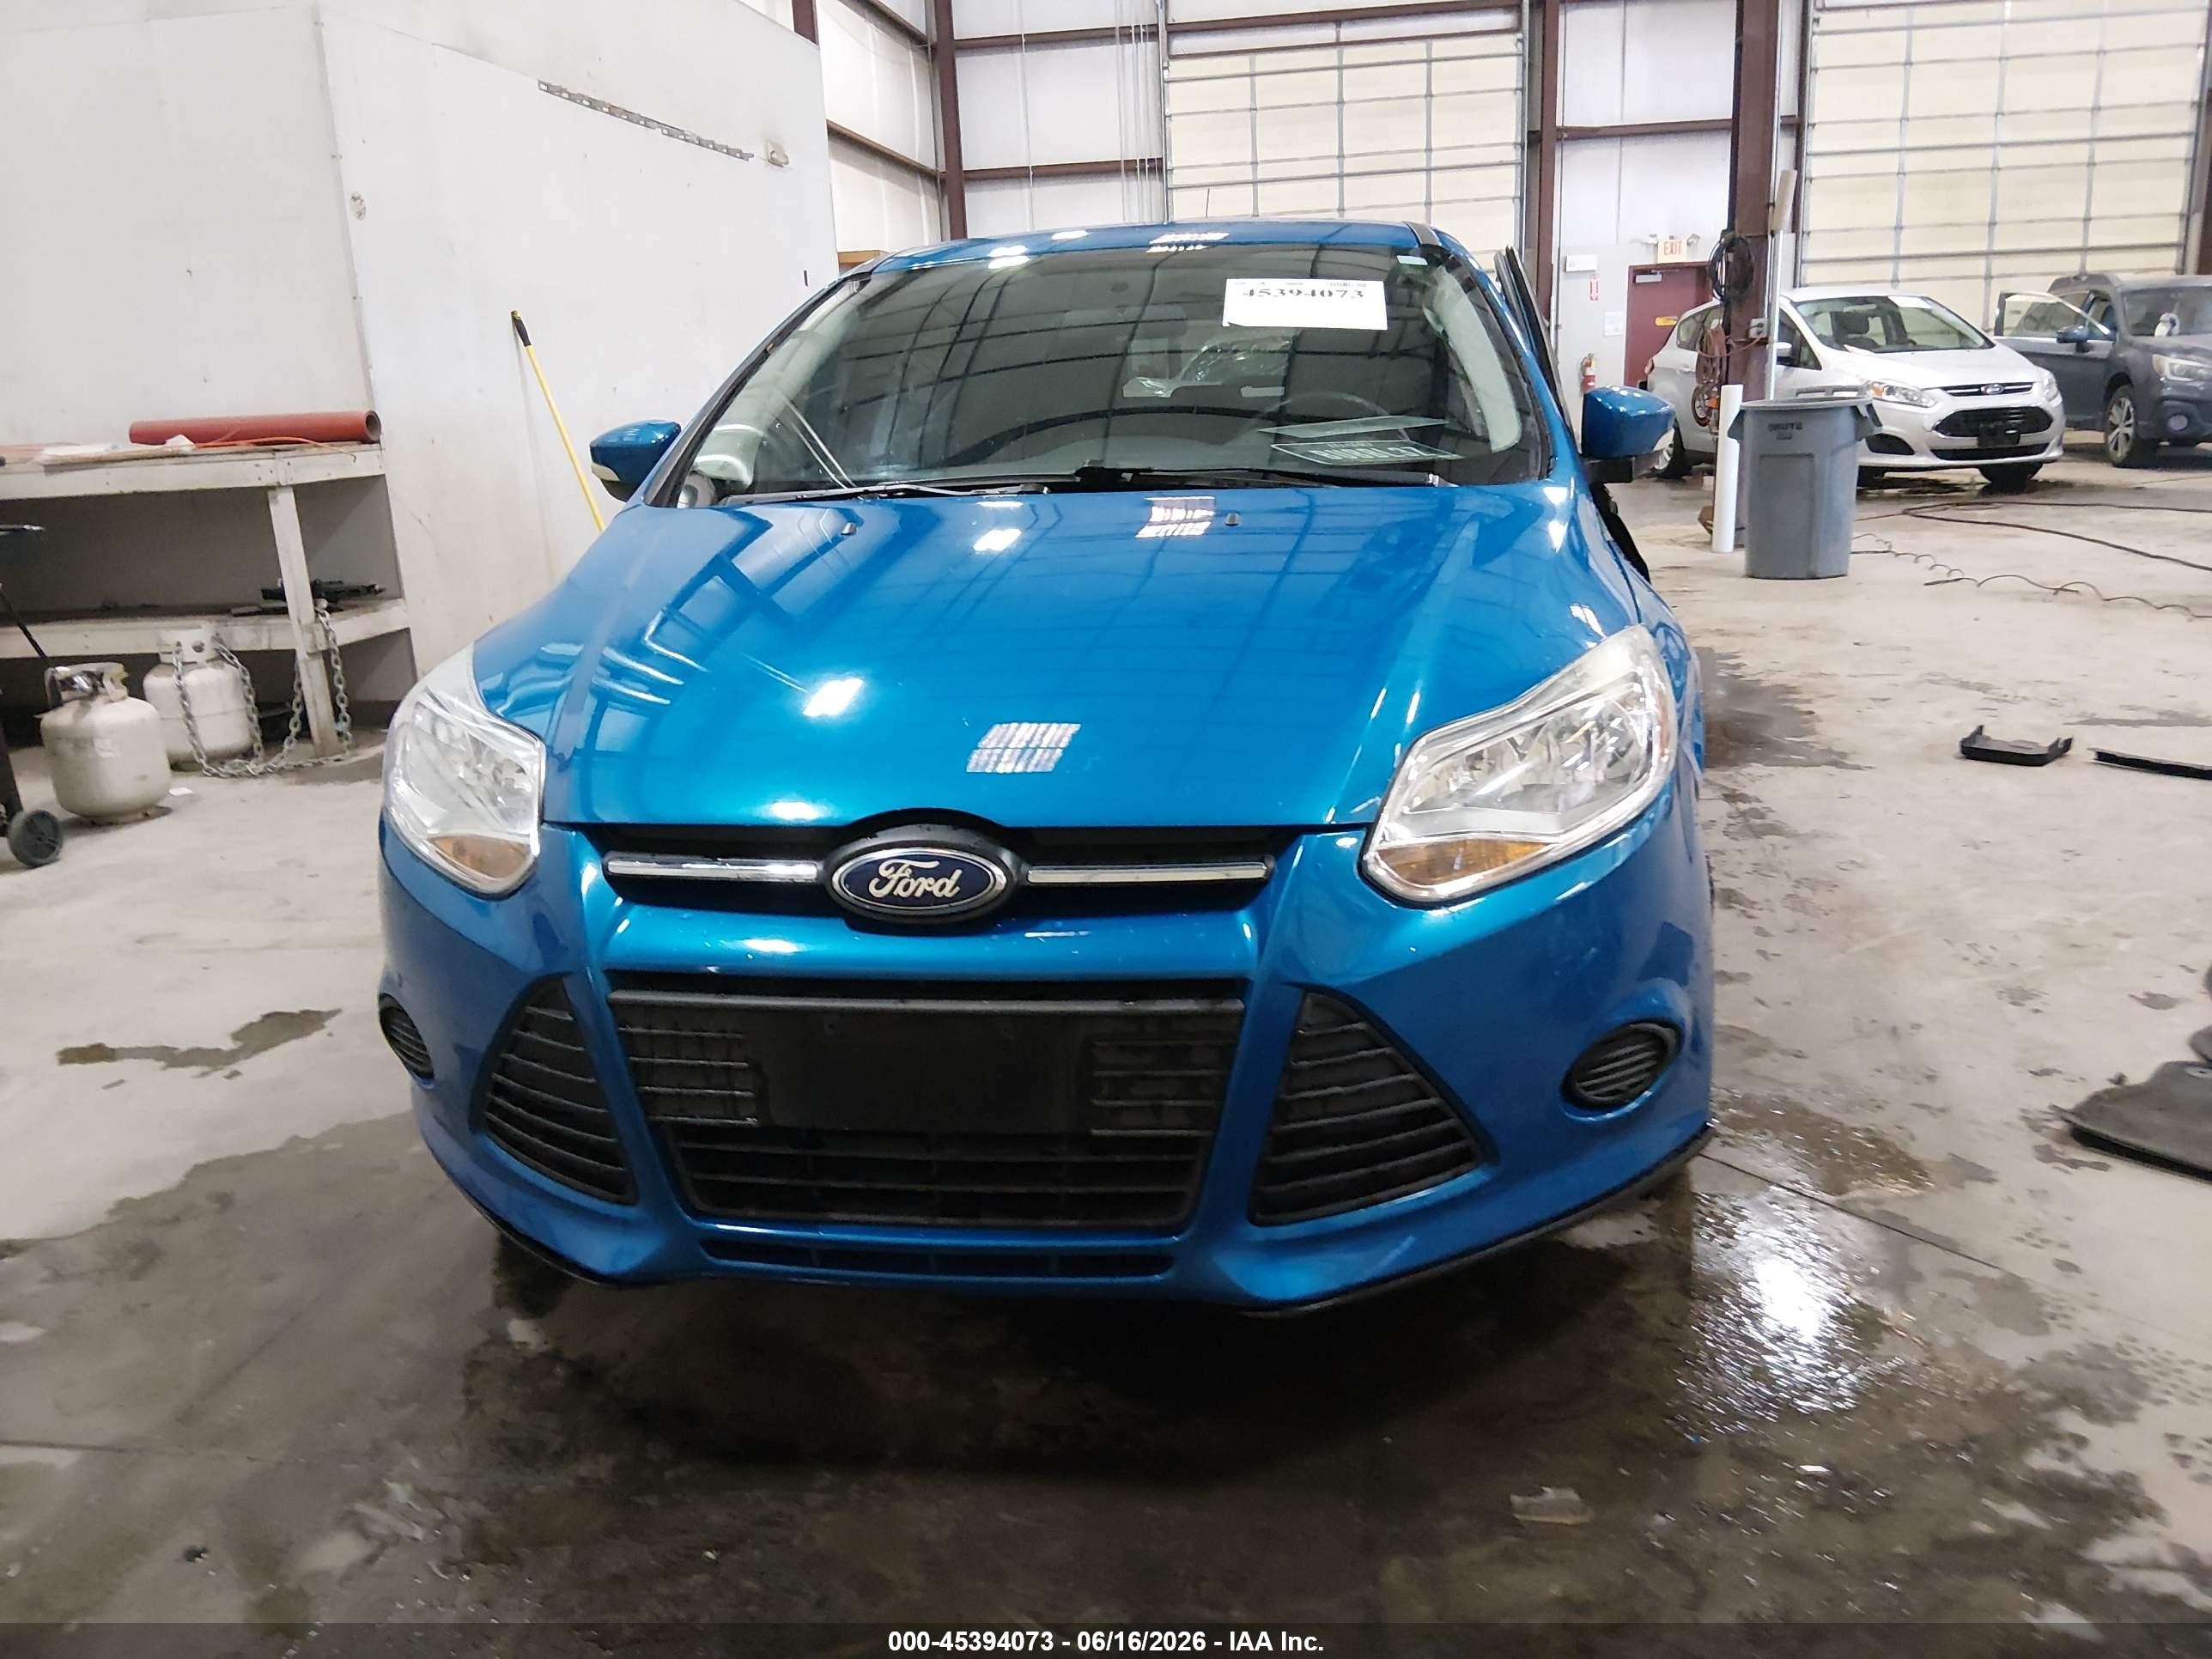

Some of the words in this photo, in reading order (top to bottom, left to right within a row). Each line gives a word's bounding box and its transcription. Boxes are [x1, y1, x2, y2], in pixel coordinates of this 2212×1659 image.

[1663, 240, 1682, 255] EXIT
[1243, 288, 1364, 299] 45394073
[868, 859, 963, 897] Ford
